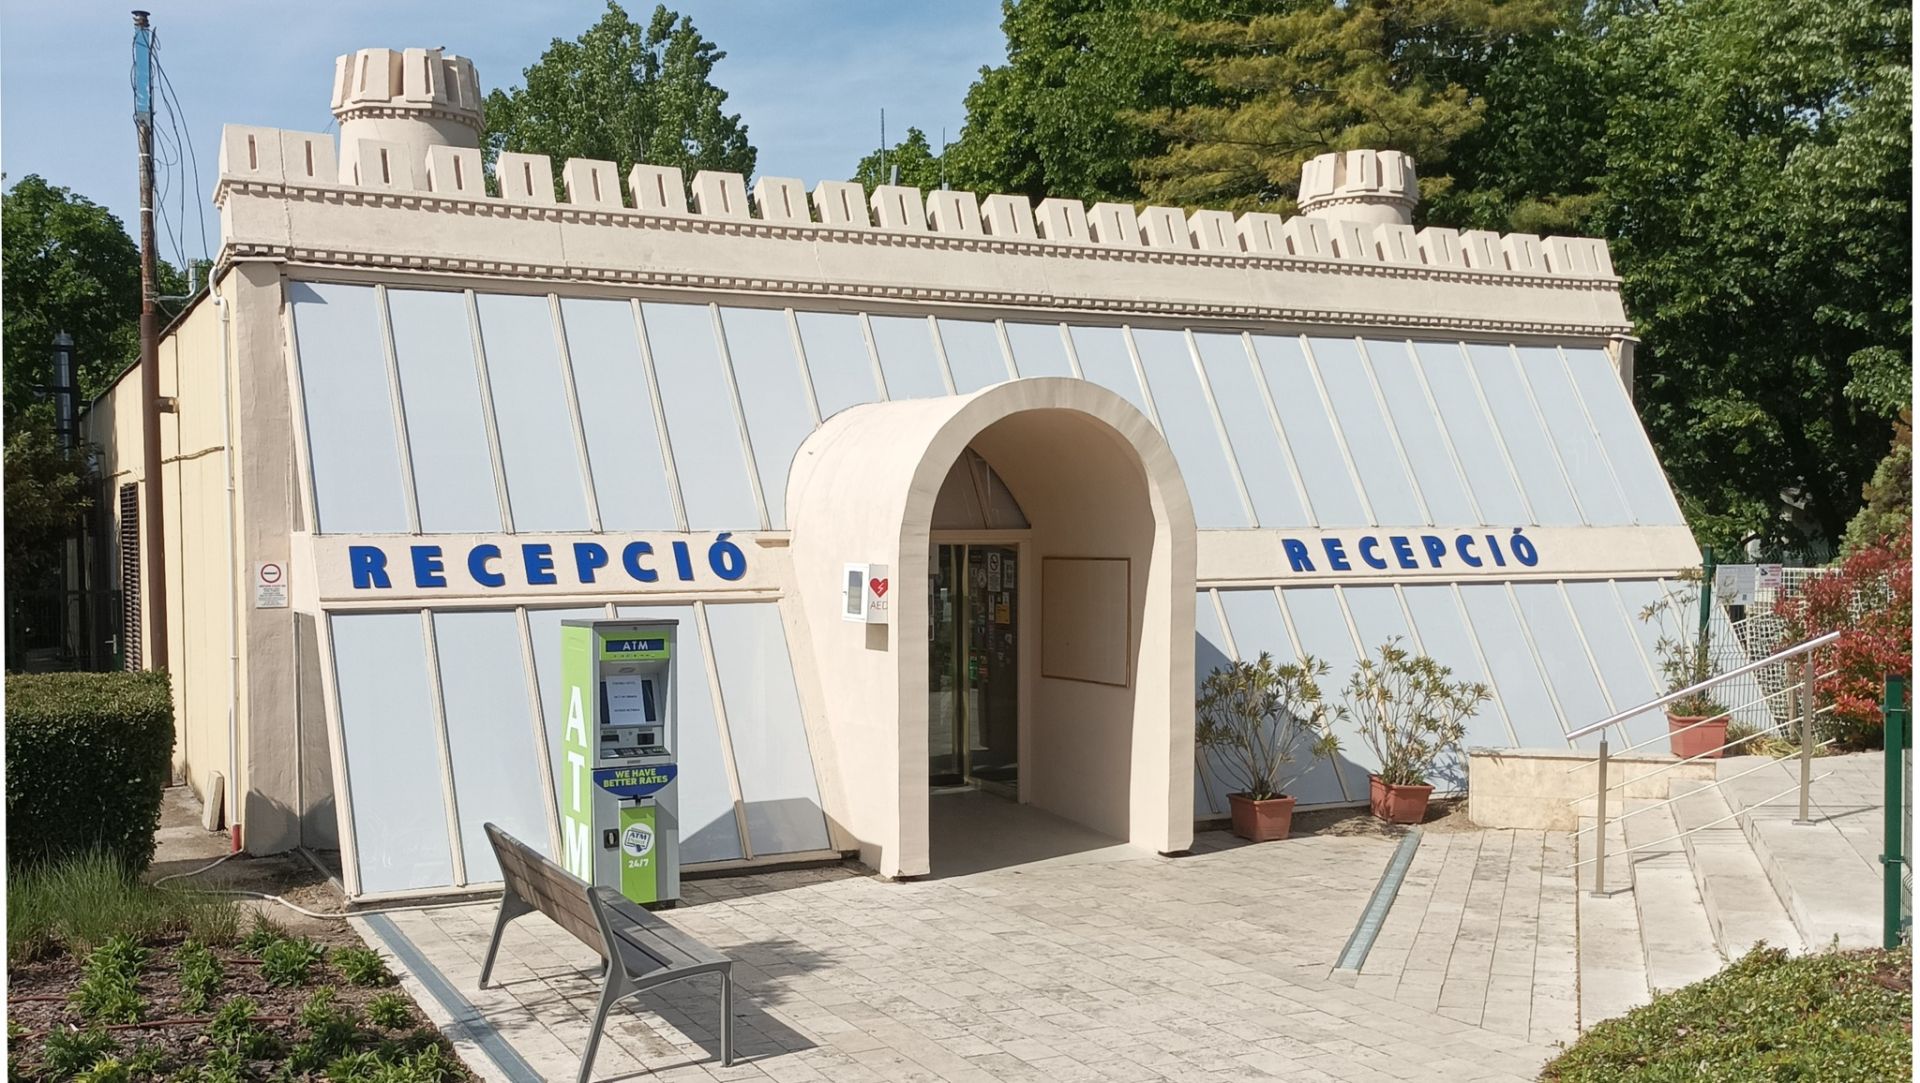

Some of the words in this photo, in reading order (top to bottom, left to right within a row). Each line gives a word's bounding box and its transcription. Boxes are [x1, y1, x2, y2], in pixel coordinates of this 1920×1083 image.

[1281, 527, 1539, 572] RECEPCIÓ
[349, 532, 747, 589] RECEPCIÓ
[622, 641, 648, 651] ATM
[615, 770, 630, 778] WE
[632, 768, 656, 777] HAVE
[565, 685, 589, 884] ATM
[603, 778, 637, 788] BETTER
[639, 775, 668, 785] RATES
[629, 832, 647, 840] ATM
[628, 858, 648, 868] 24/7
